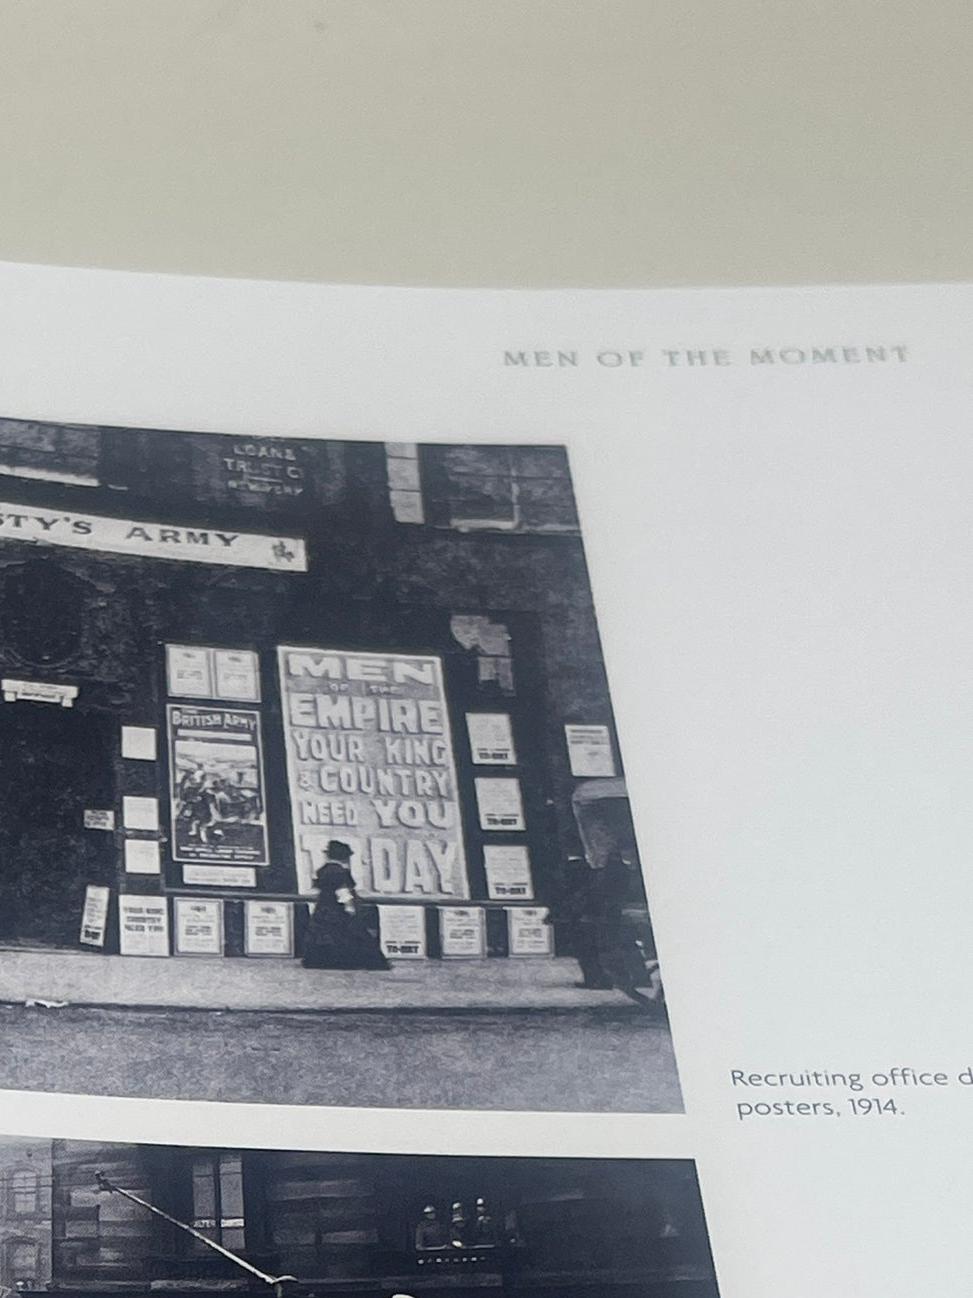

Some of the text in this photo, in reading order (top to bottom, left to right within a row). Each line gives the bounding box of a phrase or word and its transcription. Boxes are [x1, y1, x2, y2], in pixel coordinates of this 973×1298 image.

[503, 345, 909, 368] MEN OF THE MOMENT
[125, 525, 240, 548] ARMY
[288, 654, 433, 685] MEN
[172, 710, 257, 731] BRITISH ARMY
[289, 694, 443, 735] EMPIRE
[292, 731, 447, 768] YOUR KING
[298, 764, 448, 798] & COUNTRY
[301, 799, 455, 829] NEED YOU
[731, 1068, 864, 1092] Recruiting
[872, 1067, 948, 1086] office
[737, 1098, 905, 1121] posters, 1914.
